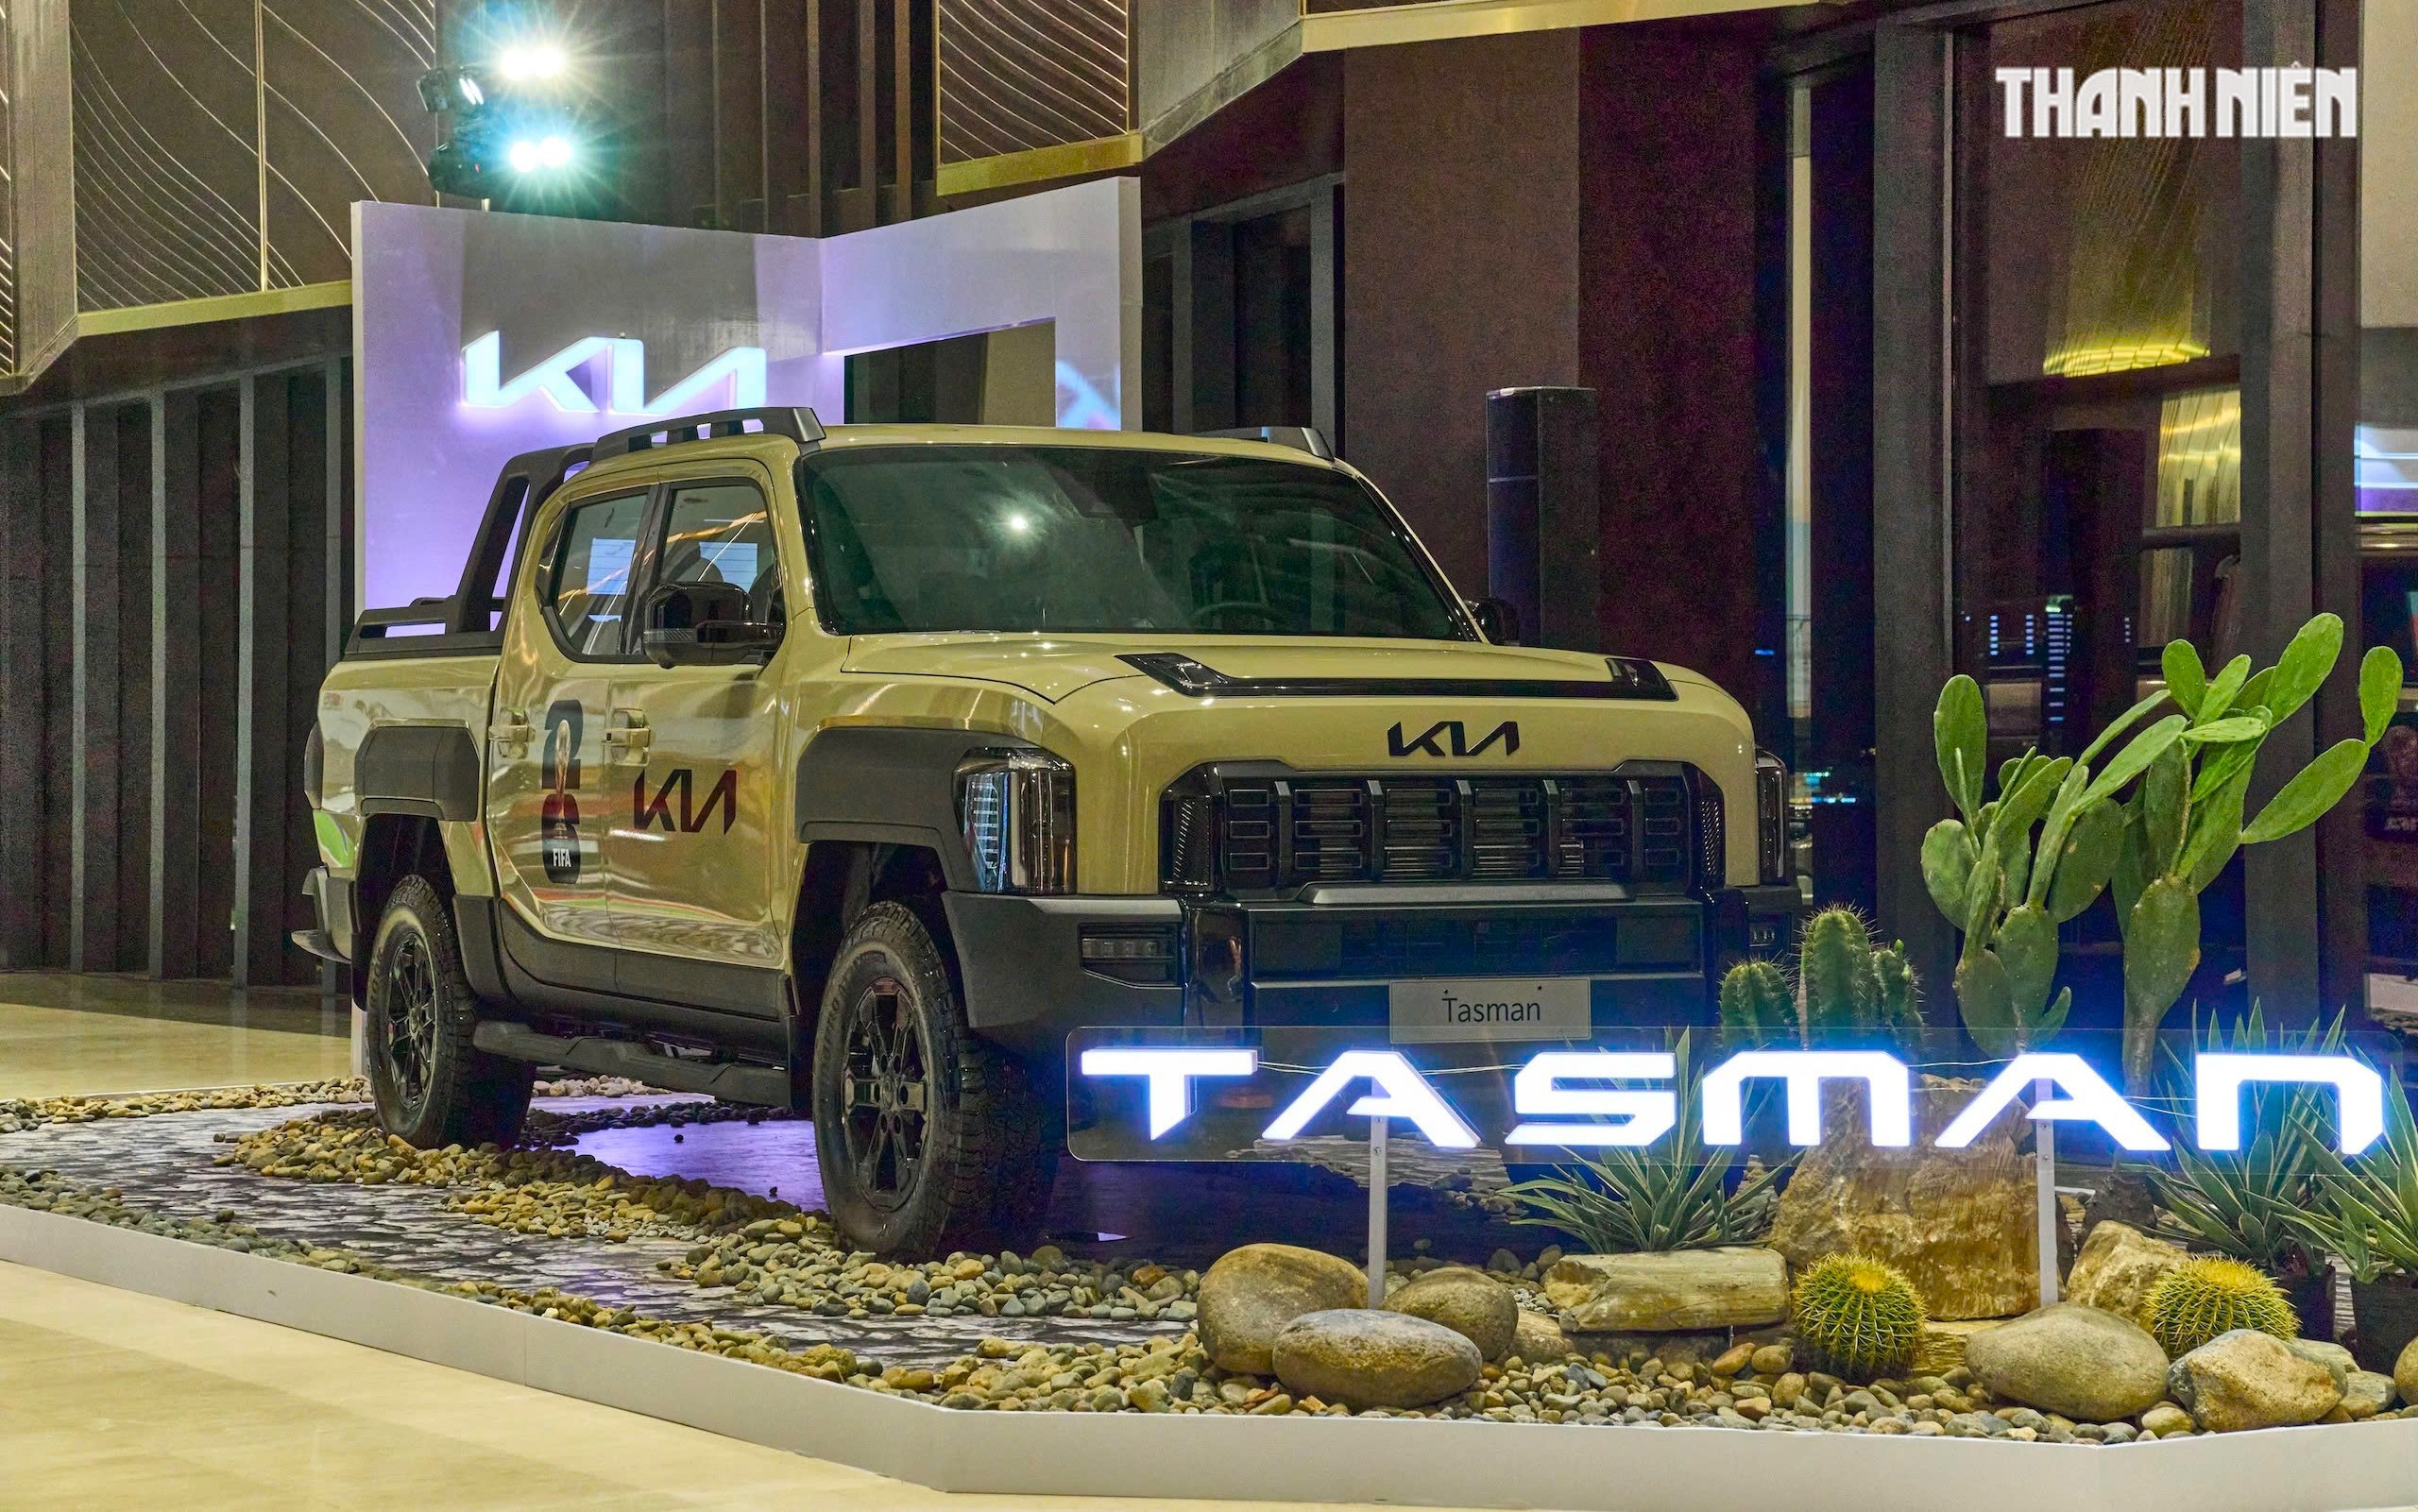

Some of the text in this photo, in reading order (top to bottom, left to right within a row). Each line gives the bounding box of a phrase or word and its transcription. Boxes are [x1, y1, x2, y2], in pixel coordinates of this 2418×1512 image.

[461, 330, 766, 415] KIA
[1388, 721, 1520, 756] KIA
[633, 769, 737, 836] KIA
[553, 848, 571, 868] FIFA
[1441, 997, 1541, 1022] Tasman
[1081, 1048, 2384, 1155] TASMAN
